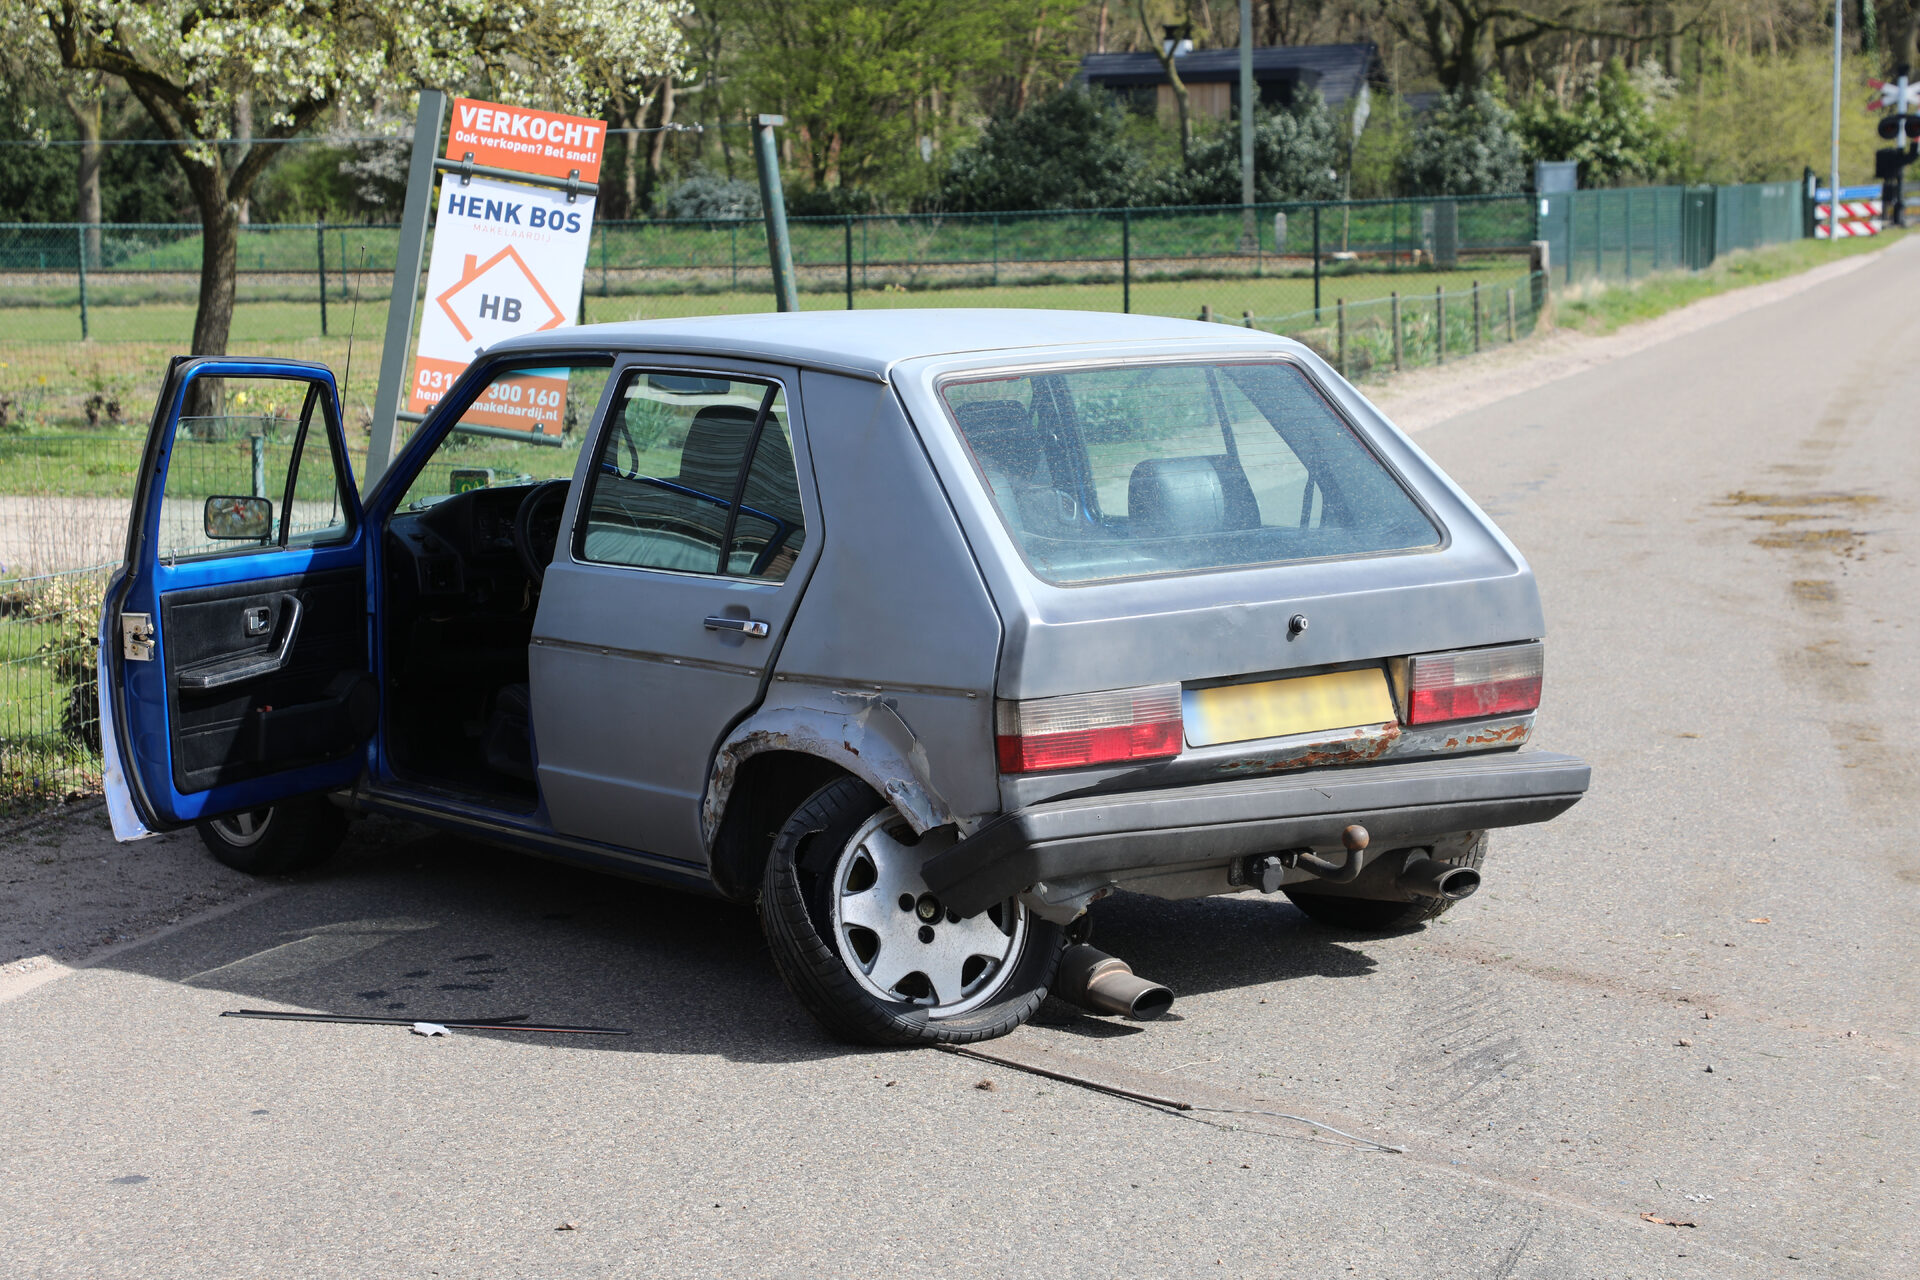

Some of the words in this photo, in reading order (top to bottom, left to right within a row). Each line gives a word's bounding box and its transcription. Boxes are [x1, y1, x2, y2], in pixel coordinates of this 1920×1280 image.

[460, 105, 600, 148] VERKOCHT
[455, 130, 478, 144] Ook
[480, 135, 543, 154] verkopen?
[544, 145, 564, 158] Bel
[566, 150, 597, 163] snel!
[448, 193, 523, 225] HENK
[529, 206, 582, 234] BOS
[472, 223, 552, 243] MAKELAARDIJ
[479, 293, 522, 323] HB
[419, 369, 461, 391] 031
[488, 382, 522, 402] 300
[527, 387, 560, 408] 160
